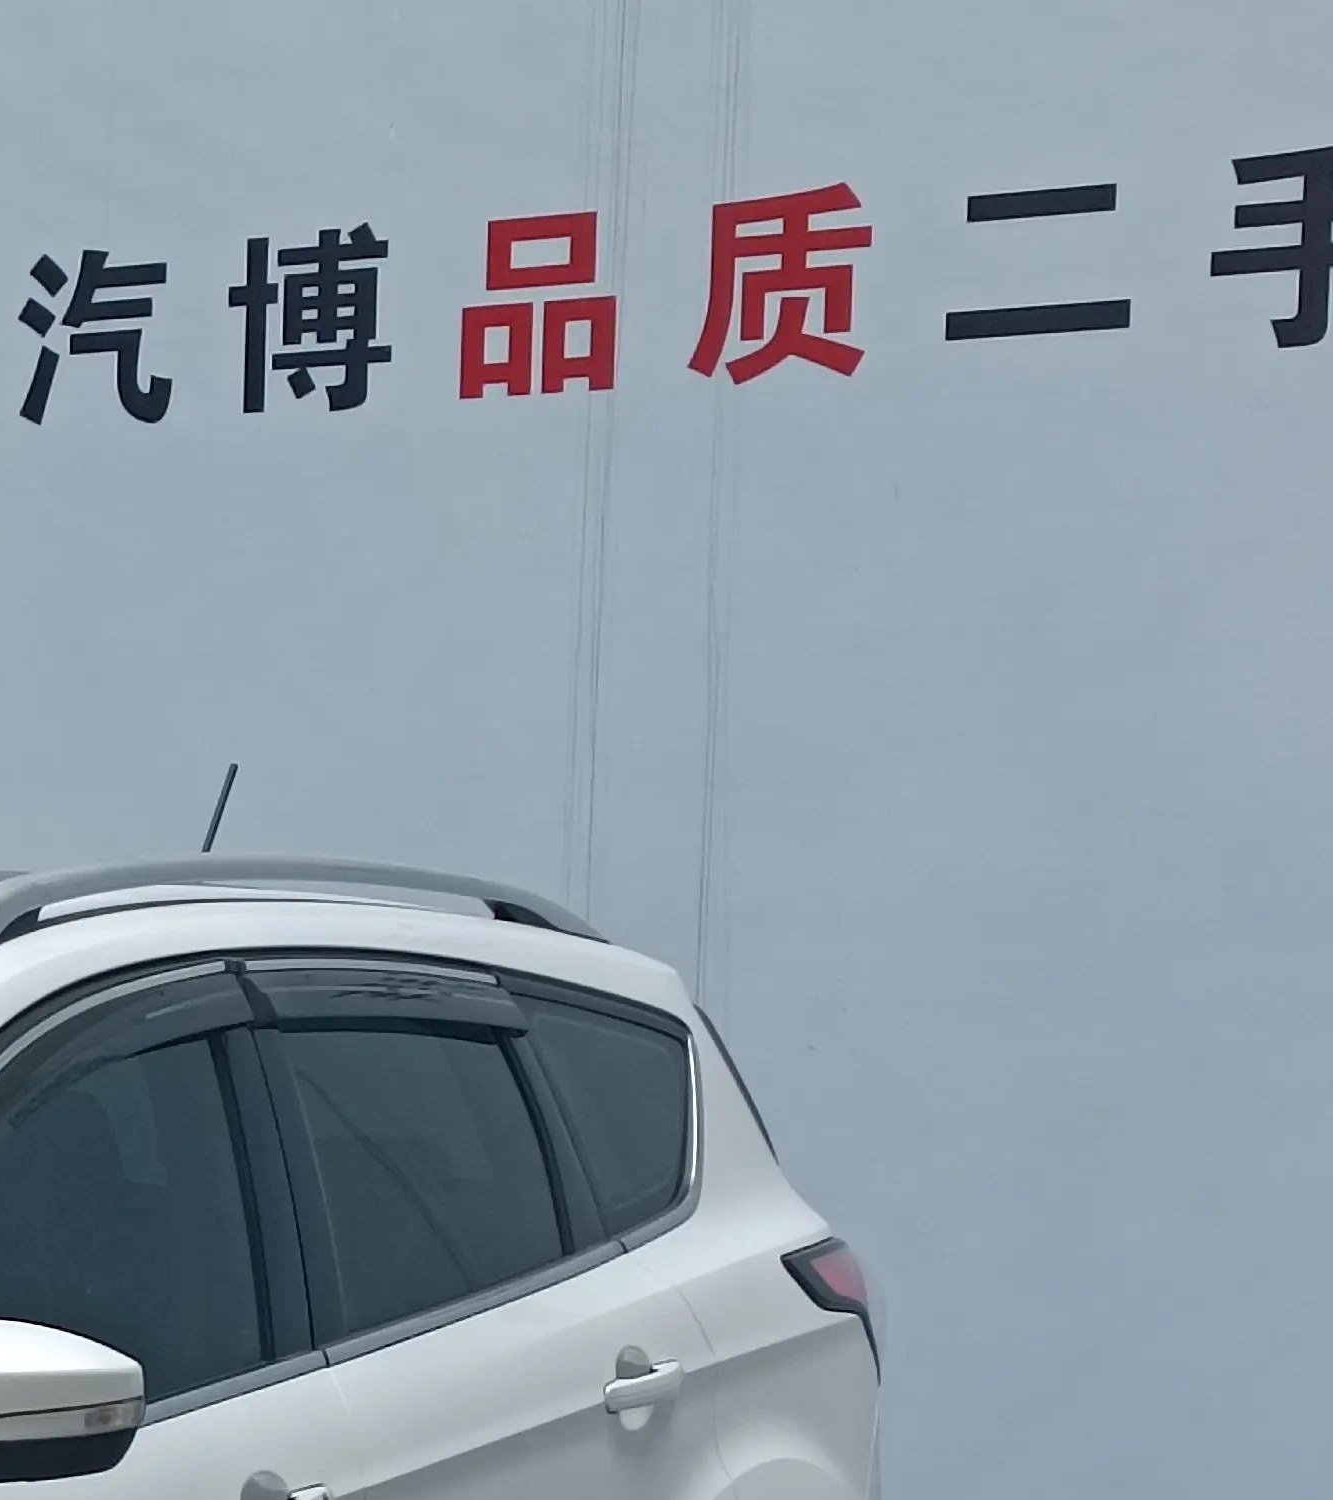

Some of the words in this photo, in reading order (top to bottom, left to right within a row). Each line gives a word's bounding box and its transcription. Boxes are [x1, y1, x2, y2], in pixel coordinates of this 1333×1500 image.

[19, 146, 1333, 425] 汽博品质二手
